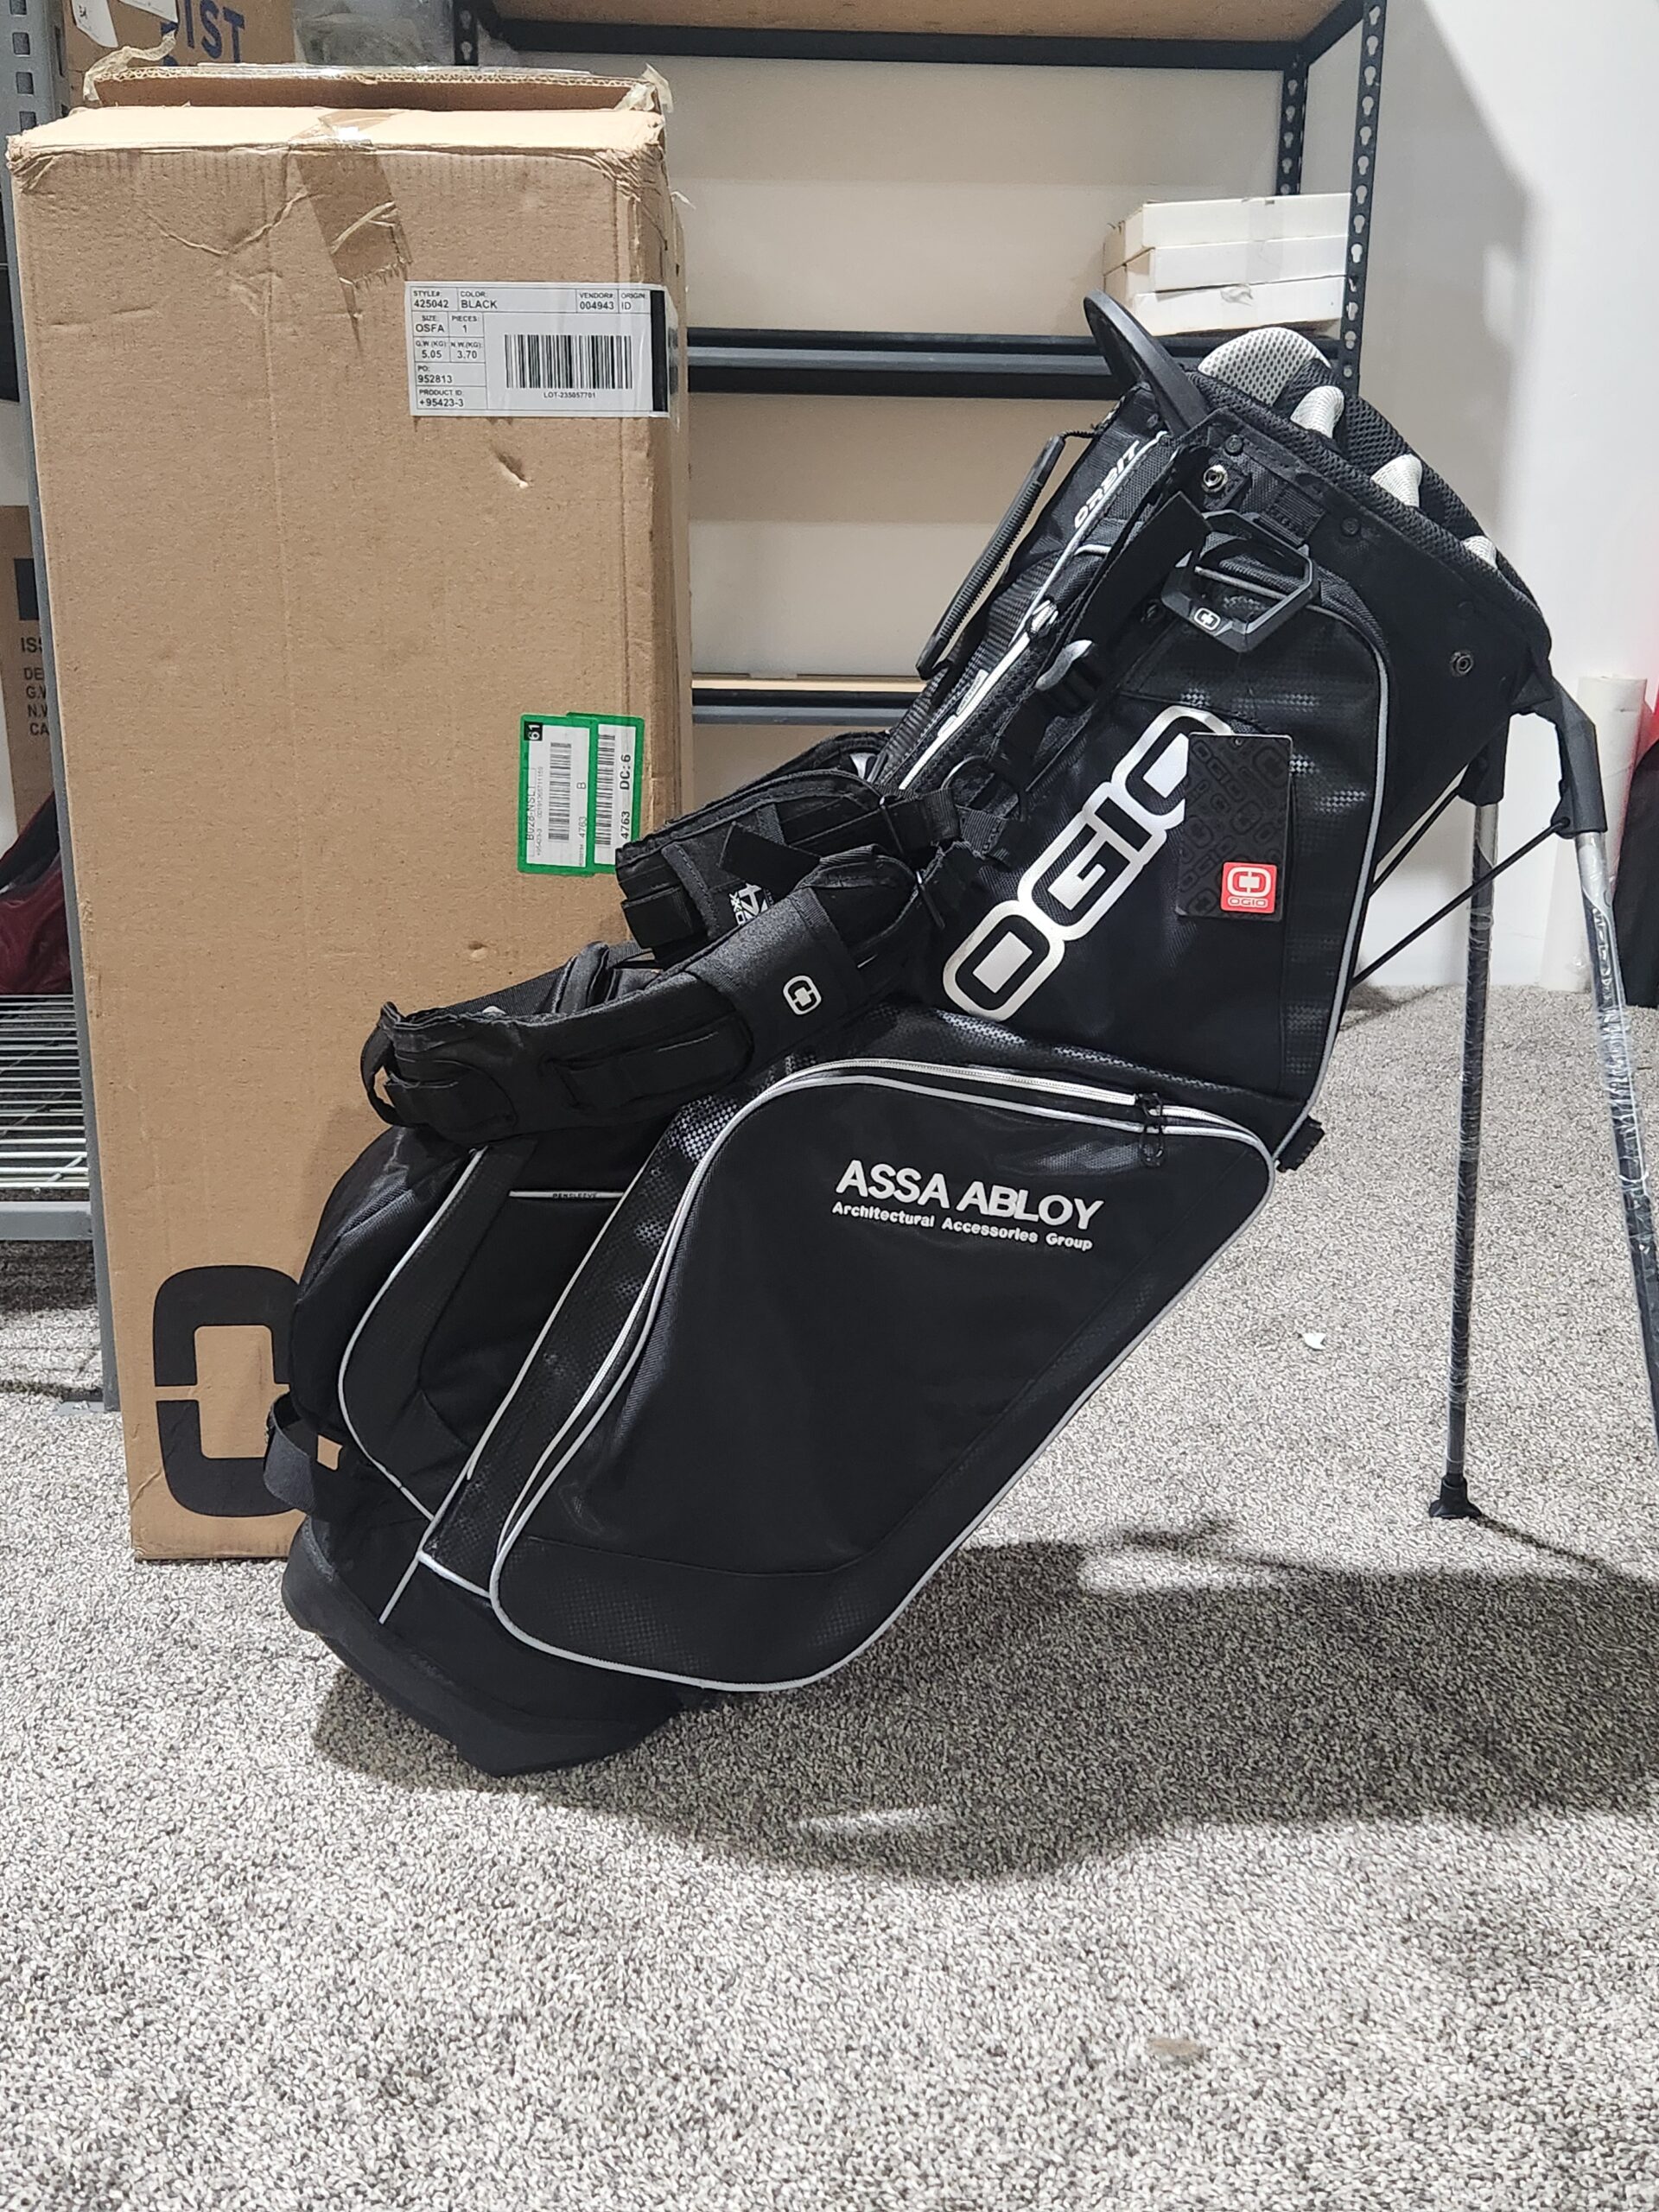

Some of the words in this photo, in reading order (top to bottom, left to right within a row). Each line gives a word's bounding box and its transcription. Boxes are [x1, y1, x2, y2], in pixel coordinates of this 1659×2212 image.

[414, 299, 449, 308] 425042
[461, 300, 498, 308] BLACK
[621, 302, 632, 310] ID
[415, 324, 445, 333] OSFA
[462, 324, 467, 334] 1
[422, 349, 442, 359] 5.05
[457, 350, 478, 359] 3.70
[417, 374, 453, 384] 952813
[419, 398, 464, 407] +95423-3
[1074, 440, 1140, 529] ORBIT
[20, 637, 42, 653] IS
[528, 724, 541, 741] 61
[578, 816, 588, 838] 4763
[620, 810, 631, 840] 4763
[943, 705, 1234, 1022] OGIO
[1229, 897, 1268, 907] OGIO
[836, 1160, 950, 1209] ASSA
[957, 1181, 1104, 1230] ABLOY
[831, 1201, 935, 1228] Architectural
[942, 1217, 1039, 1243] Accessories
[1046, 1233, 1093, 1251] Group
